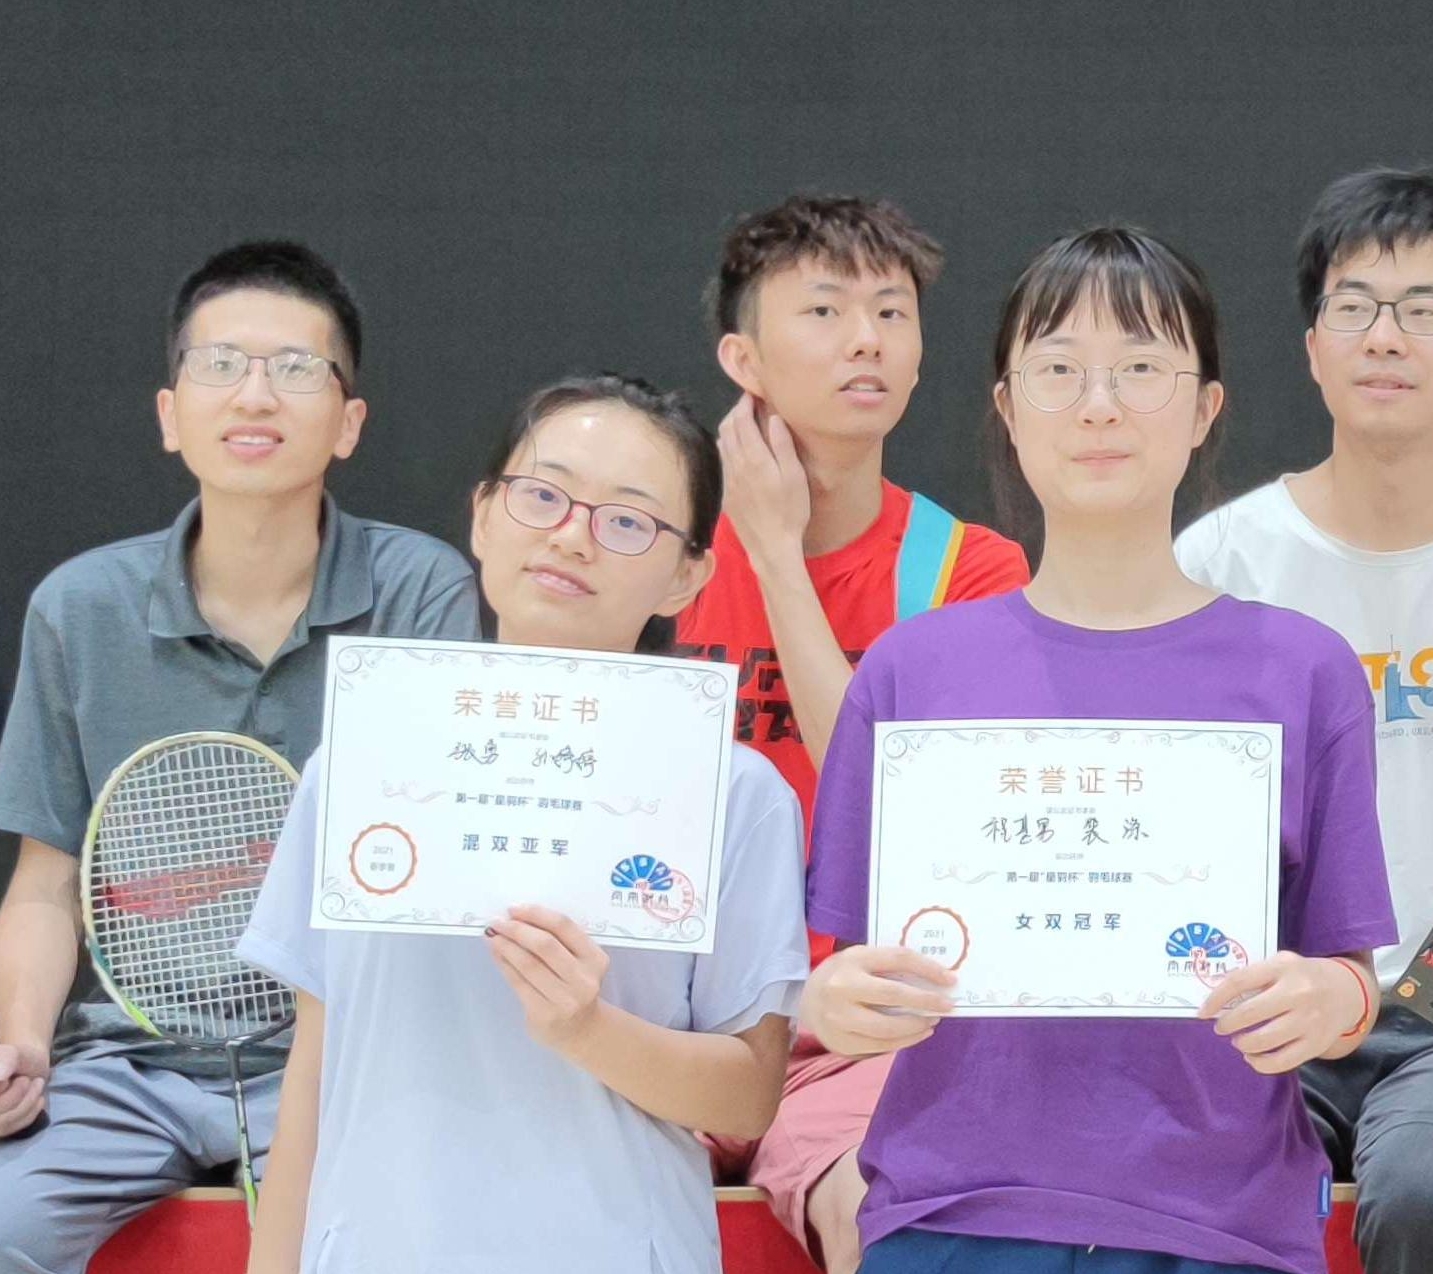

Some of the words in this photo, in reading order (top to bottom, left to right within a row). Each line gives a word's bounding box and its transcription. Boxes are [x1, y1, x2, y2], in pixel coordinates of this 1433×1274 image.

[454, 689, 600, 724] 荣誉证书
[998, 766, 1145, 796] 荣誉证书
[461, 833, 570, 857] 混双亚军
[1015, 912, 1122, 932] 女双冠军
